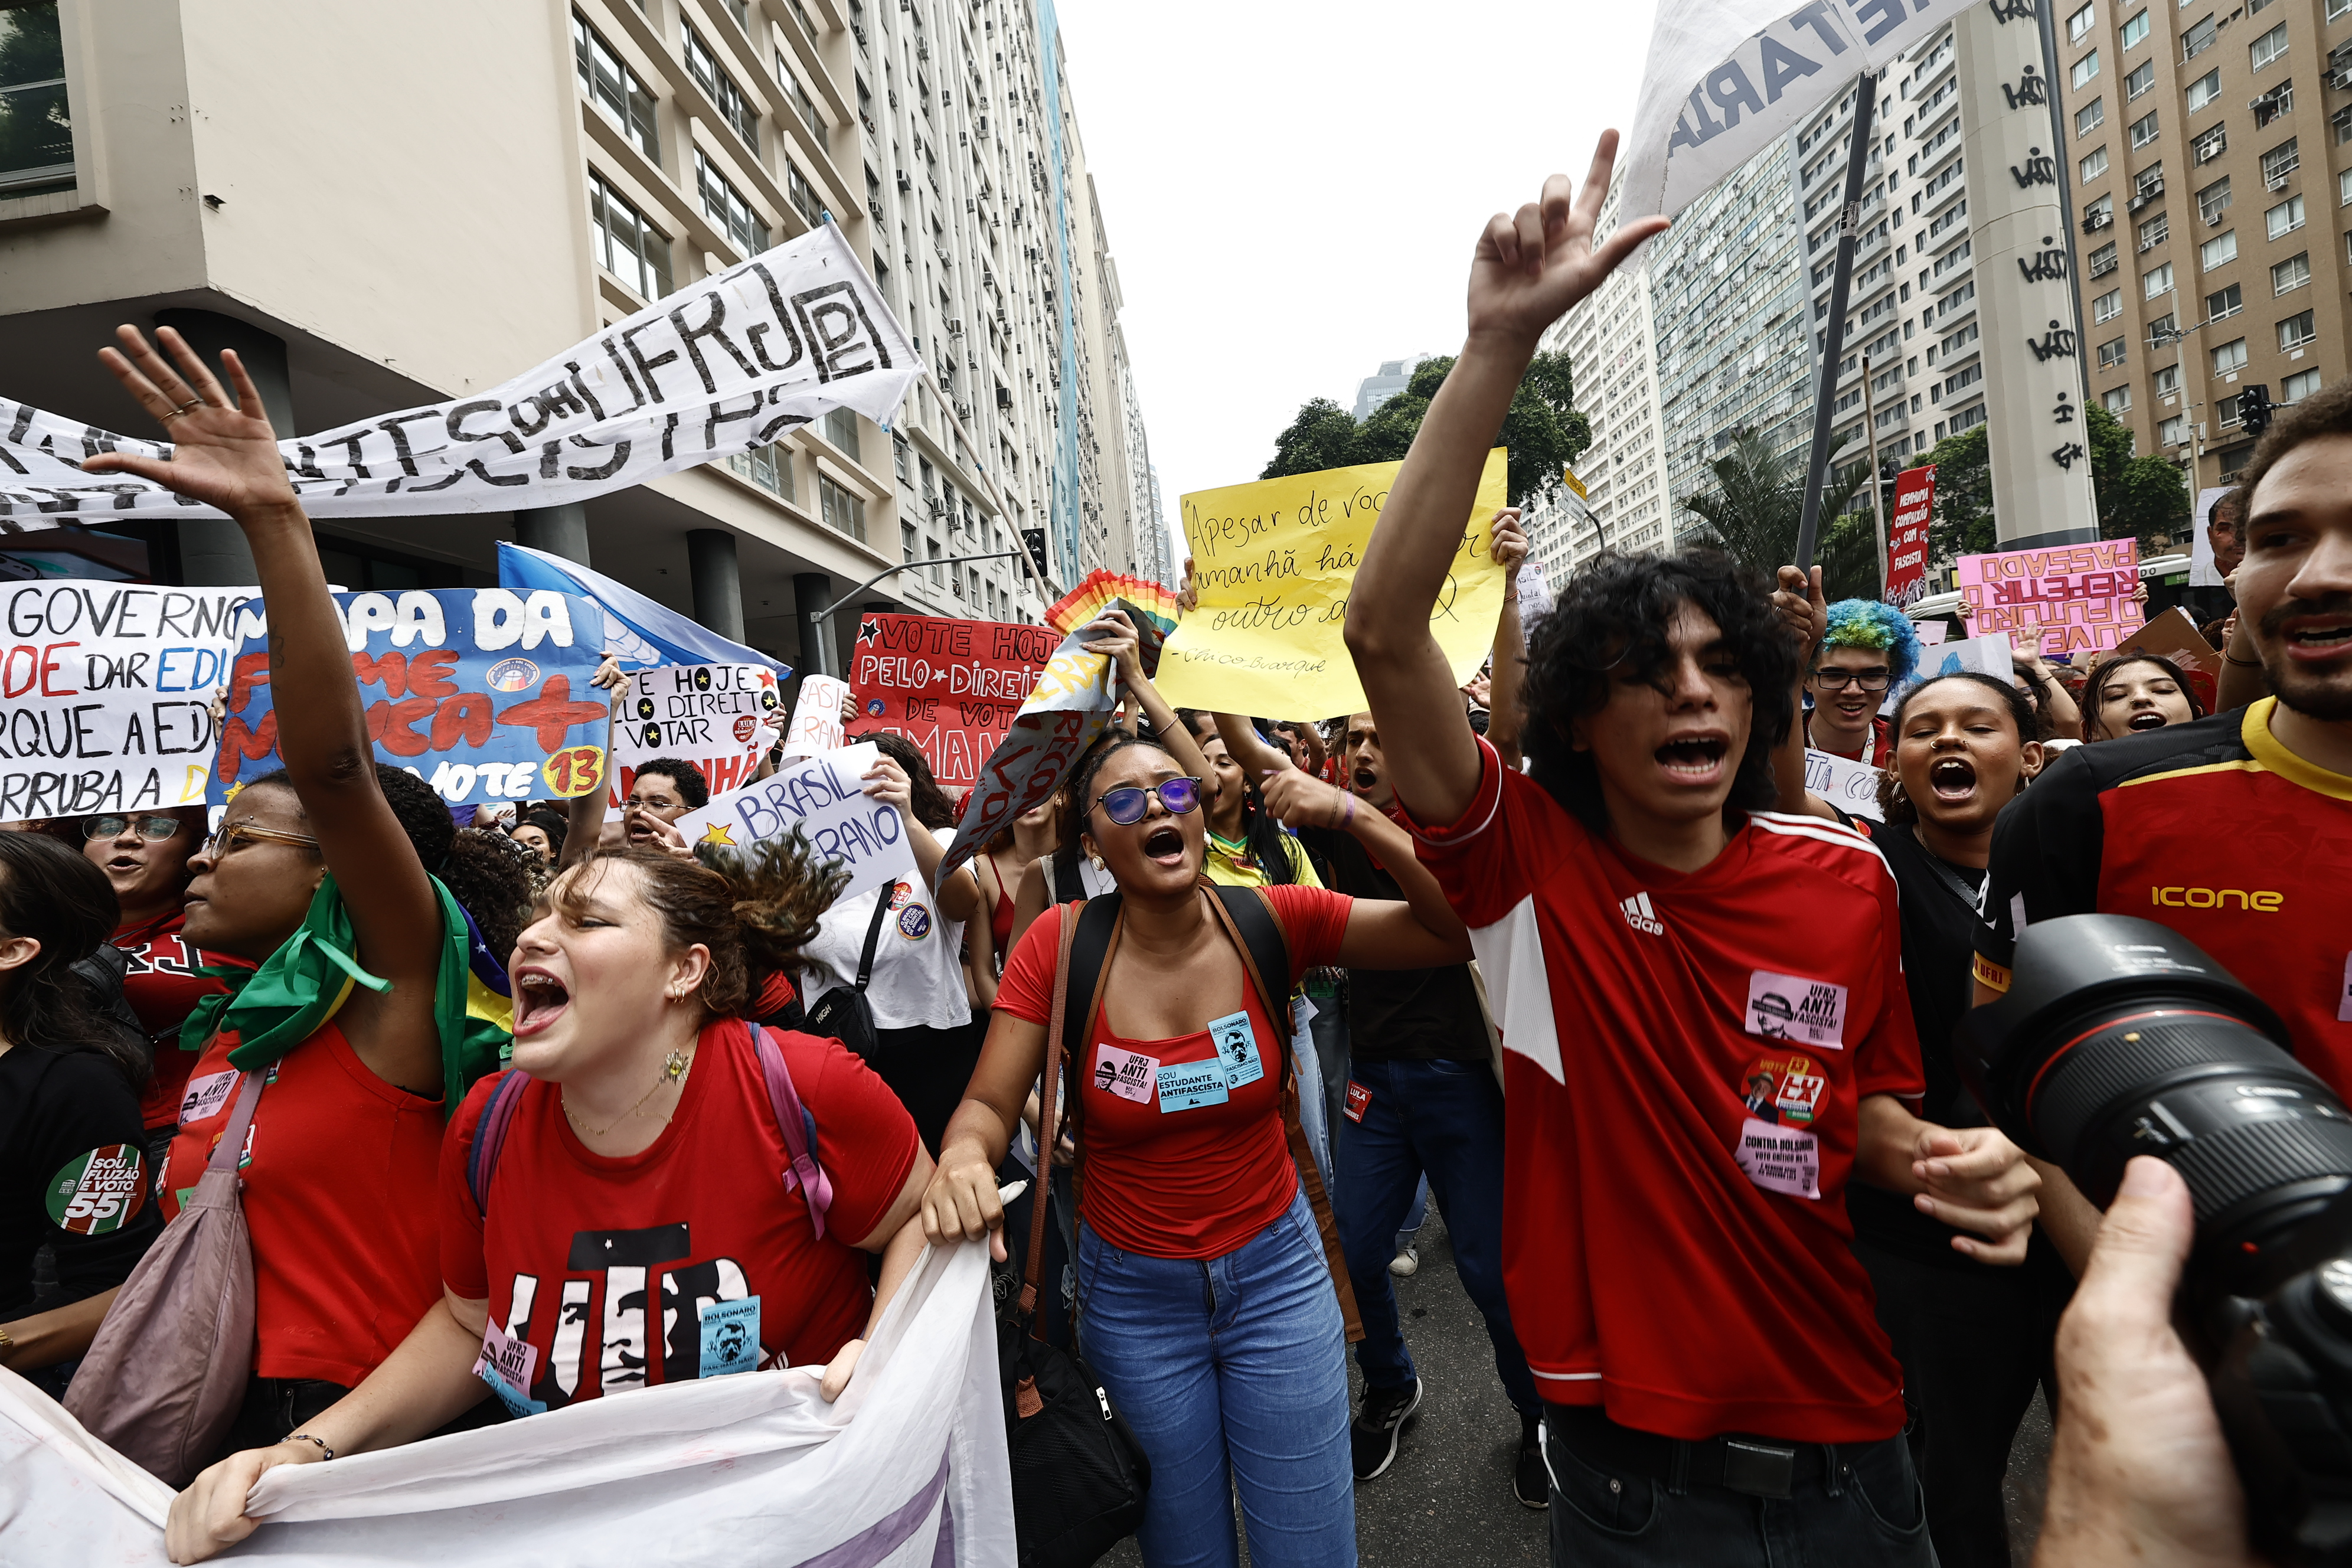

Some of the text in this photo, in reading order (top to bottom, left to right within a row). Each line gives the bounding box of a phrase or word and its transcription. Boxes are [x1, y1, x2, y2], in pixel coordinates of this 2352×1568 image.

[564, 263, 802, 422] UFRJ
[1298, 489, 1332, 526] de
[1899, 487, 1929, 508] NENHUMA
[1894, 504, 1929, 529] COMPAIXÃO
[1903, 527, 1917, 544] COM
[1194, 542, 1360, 591] amanhã há
[1894, 550, 1922, 572] FASCISTA
[1981, 541, 2137, 583] PASSADO
[1963, 569, 2139, 609] REPETIR O
[234, 588, 574, 656] MPA DA
[1212, 595, 1314, 631] outro
[1977, 596, 2144, 633] O FUTURO
[879, 619, 1064, 664] VOTE HOJ
[0, 641, 80, 699] DE
[84, 652, 149, 691] DAR
[675, 667, 752, 693] HOJE
[859, 655, 930, 689] PELO
[230, 649, 460, 714] FME
[668, 690, 778, 718] DIREITO
[906, 697, 939, 722] DE
[123, 711, 146, 755] A
[625, 718, 713, 749] VOTAR
[403, 749, 598, 802] VOTE 13
[130, 767, 159, 809] A
[809, 805, 899, 864] RANO
[903, 907, 914, 922] BRASIL
[906, 909, 923, 933] NO QUINTAL
[908, 908, 919, 919] CABE
[1981, 963, 2003, 985] UFRJ
[1809, 983, 1837, 1001] UFRJ
[1799, 995, 1836, 1017] ANTI
[1212, 1018, 1247, 1033] BOLSONARO
[1794, 1011, 1837, 1031] FASCISTA!
[1120, 1063, 1148, 1080] ANTI
[1129, 1054, 1149, 1067] UFRJ
[1226, 1061, 1248, 1072] FASCISMO
[215, 1072, 236, 1084] UFRJ
[1116, 1074, 1148, 1089] FASCISTA!
[1158, 1072, 1177, 1081] SOU
[1159, 1074, 1213, 1089] ESTUDANTE
[202, 1081, 230, 1097] ANTI
[1160, 1082, 1224, 1098] ANTIFASCISTA
[1350, 1087, 1366, 1102] LULA
[196, 1093, 227, 1108] FASCISTA!
[1745, 1135, 1814, 1153] CONTRA BOLSONARO
[92, 1158, 128, 1170] SOU
[1755, 1151, 1770, 1162] VOTO
[84, 1167, 140, 1180] FLUZÃO
[78, 1180, 135, 1191] E VOTO
[64, 1191, 125, 1219] 55
[704, 1305, 756, 1321] BOLSONARO
[507, 1340, 527, 1357] UFRJ
[500, 1350, 525, 1373] ANTI
[703, 1360, 737, 1371] FASCISMO
[496, 1363, 525, 1386] FASCISTA!
